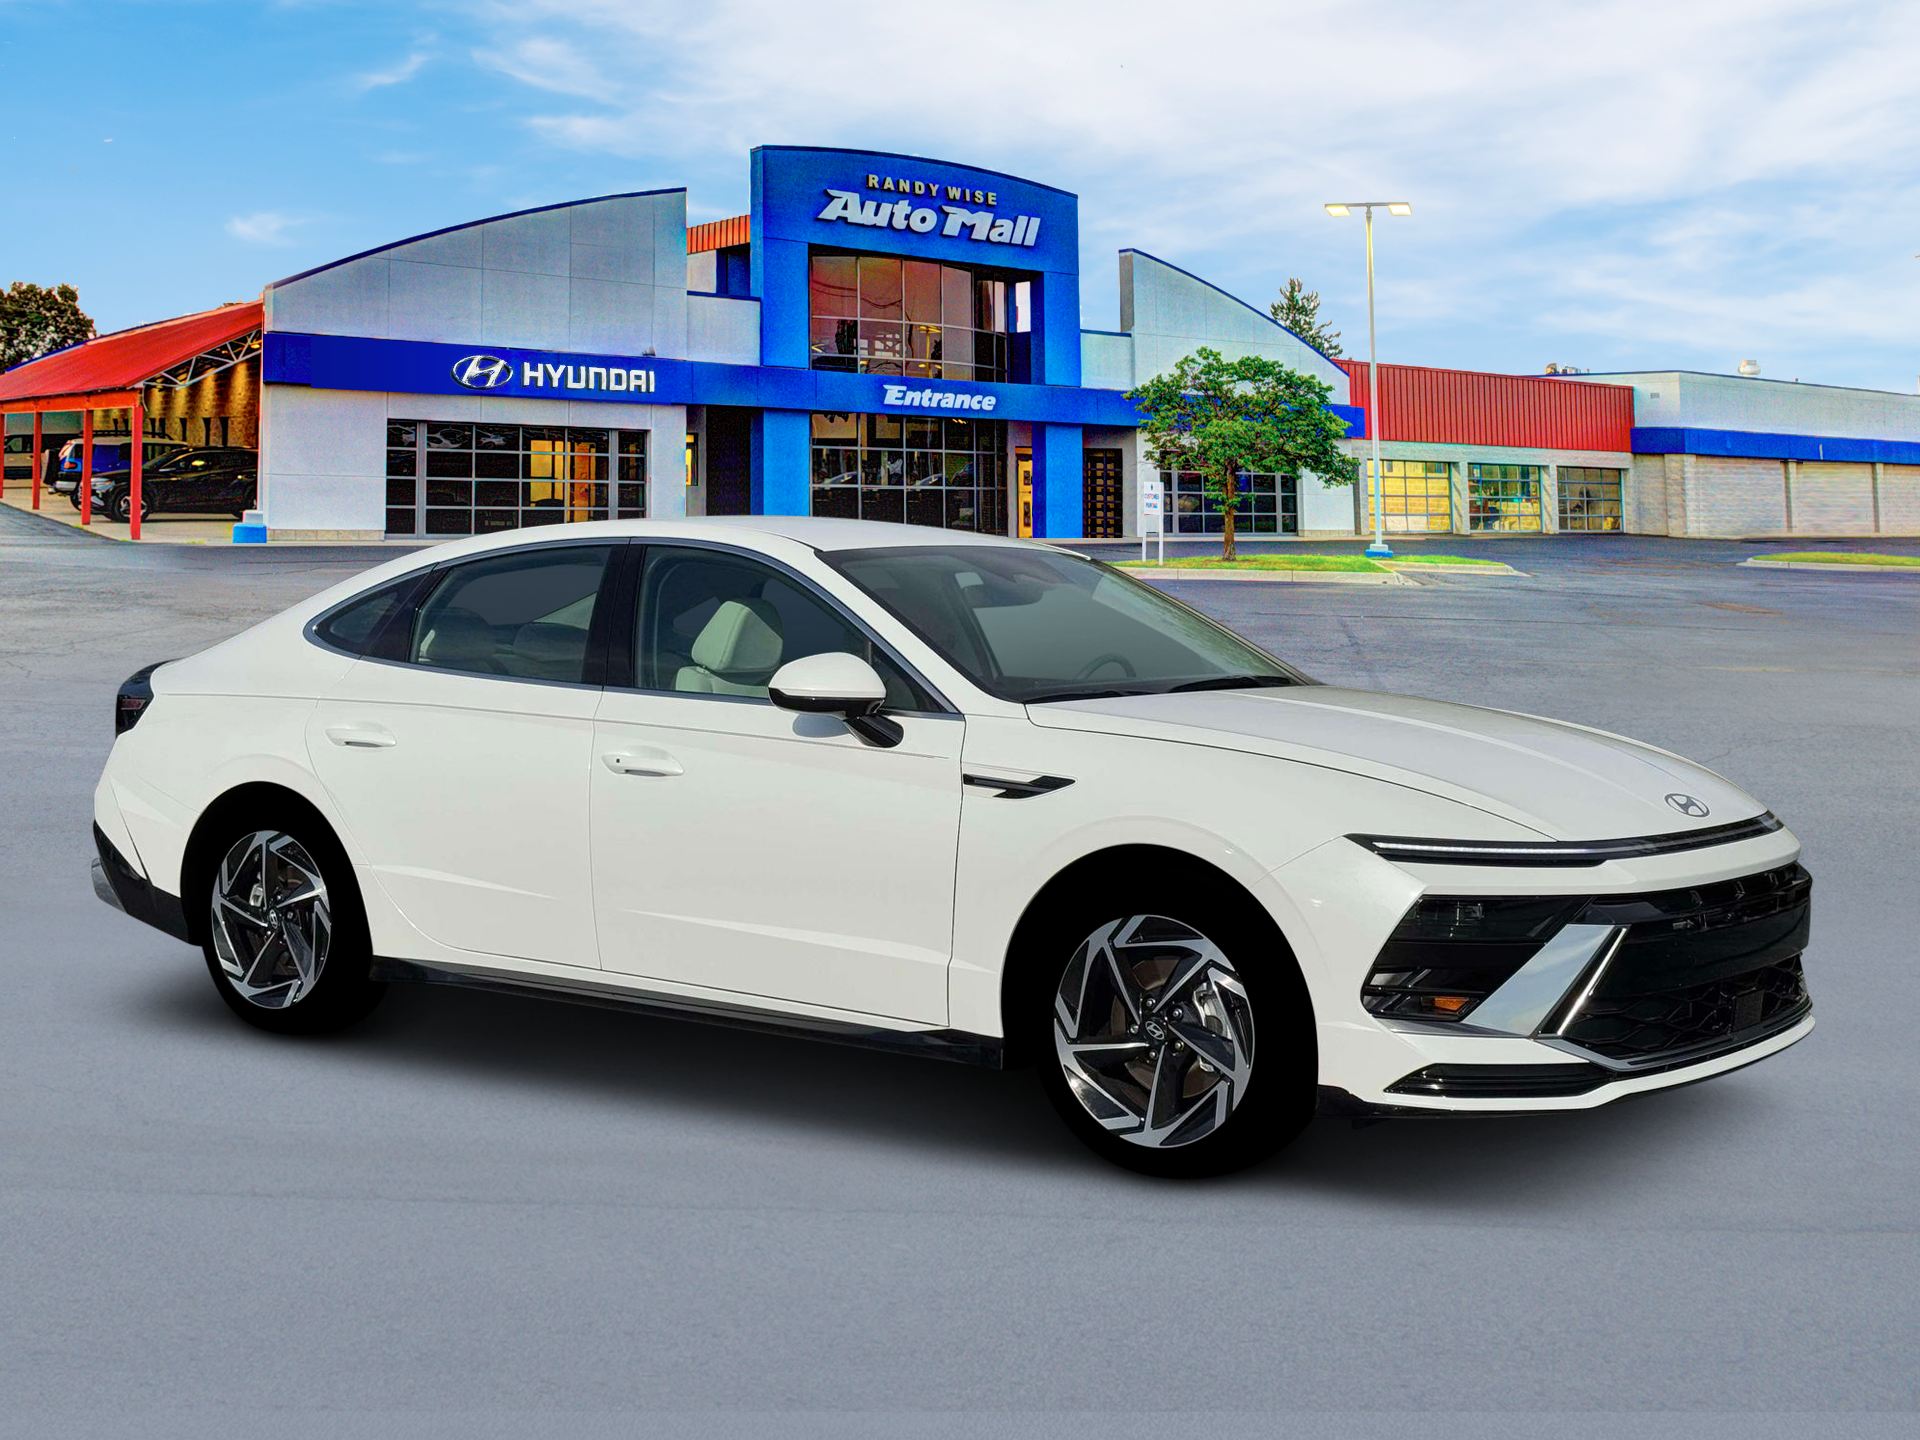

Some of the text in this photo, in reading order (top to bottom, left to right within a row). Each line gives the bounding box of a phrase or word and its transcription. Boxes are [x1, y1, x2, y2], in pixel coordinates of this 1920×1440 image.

[867, 174, 998, 205] RANDY WISE
[817, 189, 1041, 246] Auto Mall
[521, 361, 656, 393] HYUNDAI
[882, 384, 997, 411] Entrance
